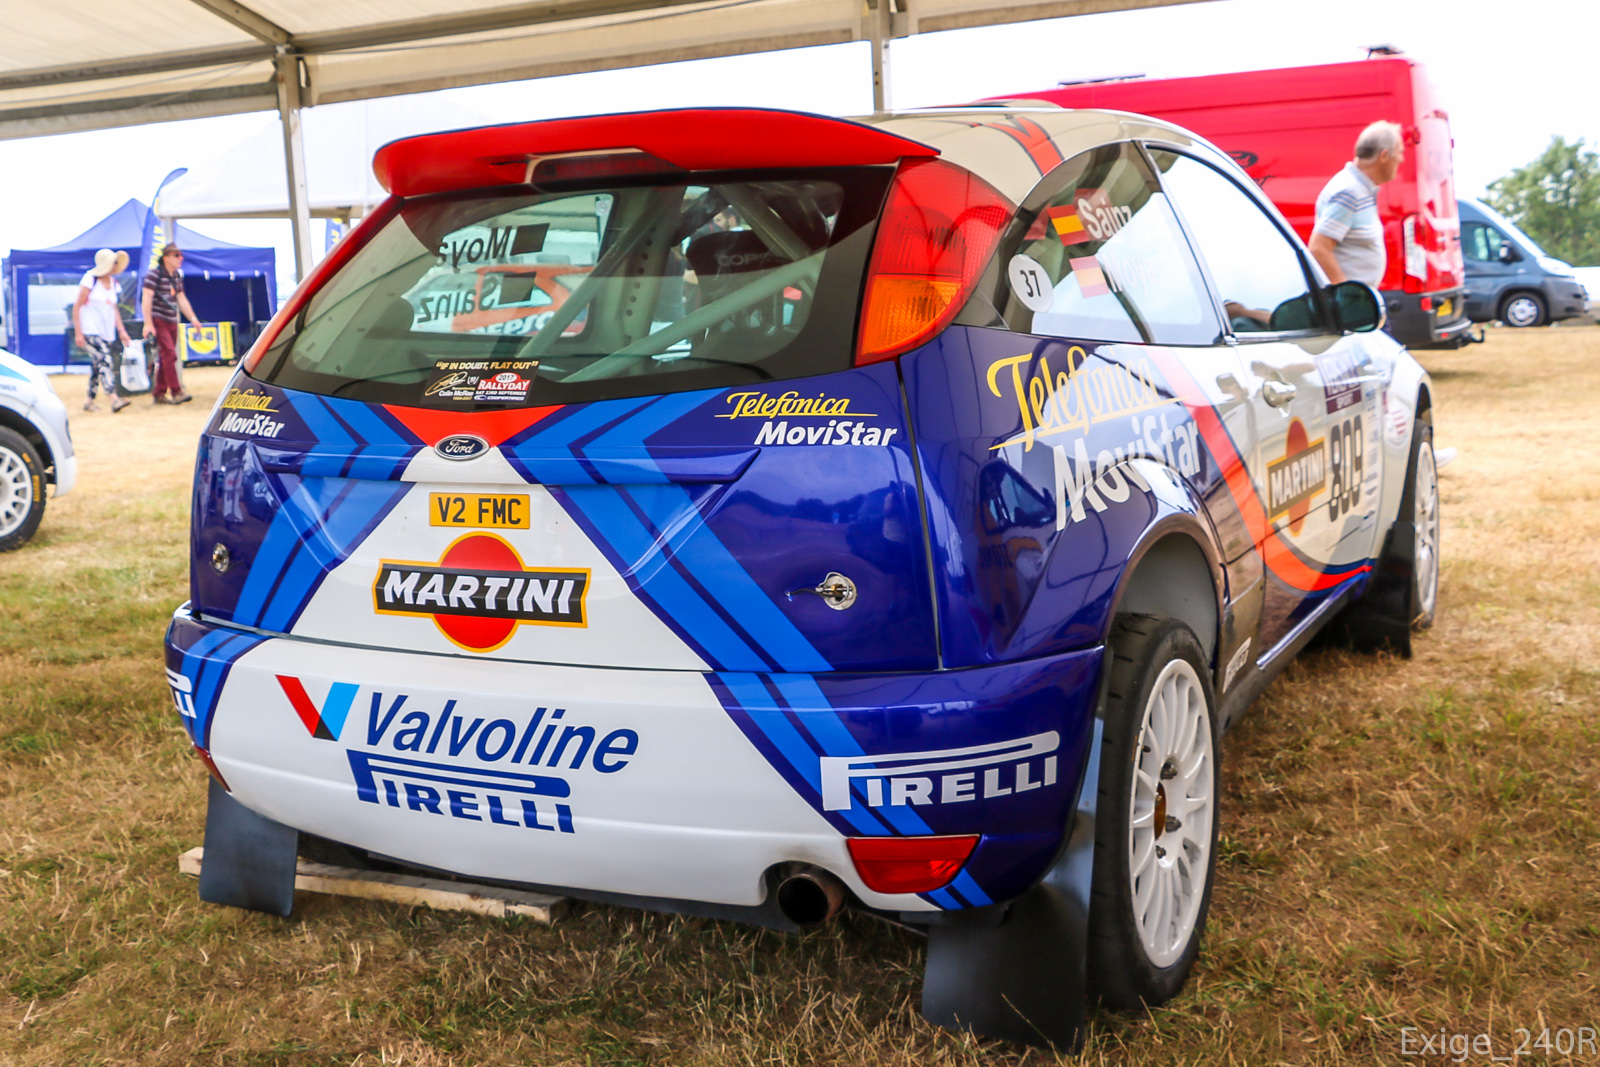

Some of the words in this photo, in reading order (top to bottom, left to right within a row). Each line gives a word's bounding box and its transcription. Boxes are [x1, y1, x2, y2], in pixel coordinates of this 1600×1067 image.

[1019, 270, 1042, 298] 37
[449, 362, 459, 370] IN
[458, 362, 489, 371] DOUBT,
[490, 362, 513, 370] FLAT
[477, 380, 531, 391] RALLYDAY
[218, 412, 285, 438] MoviStar
[753, 420, 898, 446] MoviStar
[445, 439, 476, 454] Ford
[1053, 412, 1202, 532] MoviStar
[1270, 448, 1325, 509] MARTINI
[1328, 414, 1364, 523] 809
[437, 497, 466, 523] V2
[478, 498, 522, 525] FMC
[383, 570, 575, 614] MARTINI
[366, 691, 639, 774] Valvoline
[820, 730, 1060, 811] PIRELLI
[346, 749, 575, 833] PIRELLI
